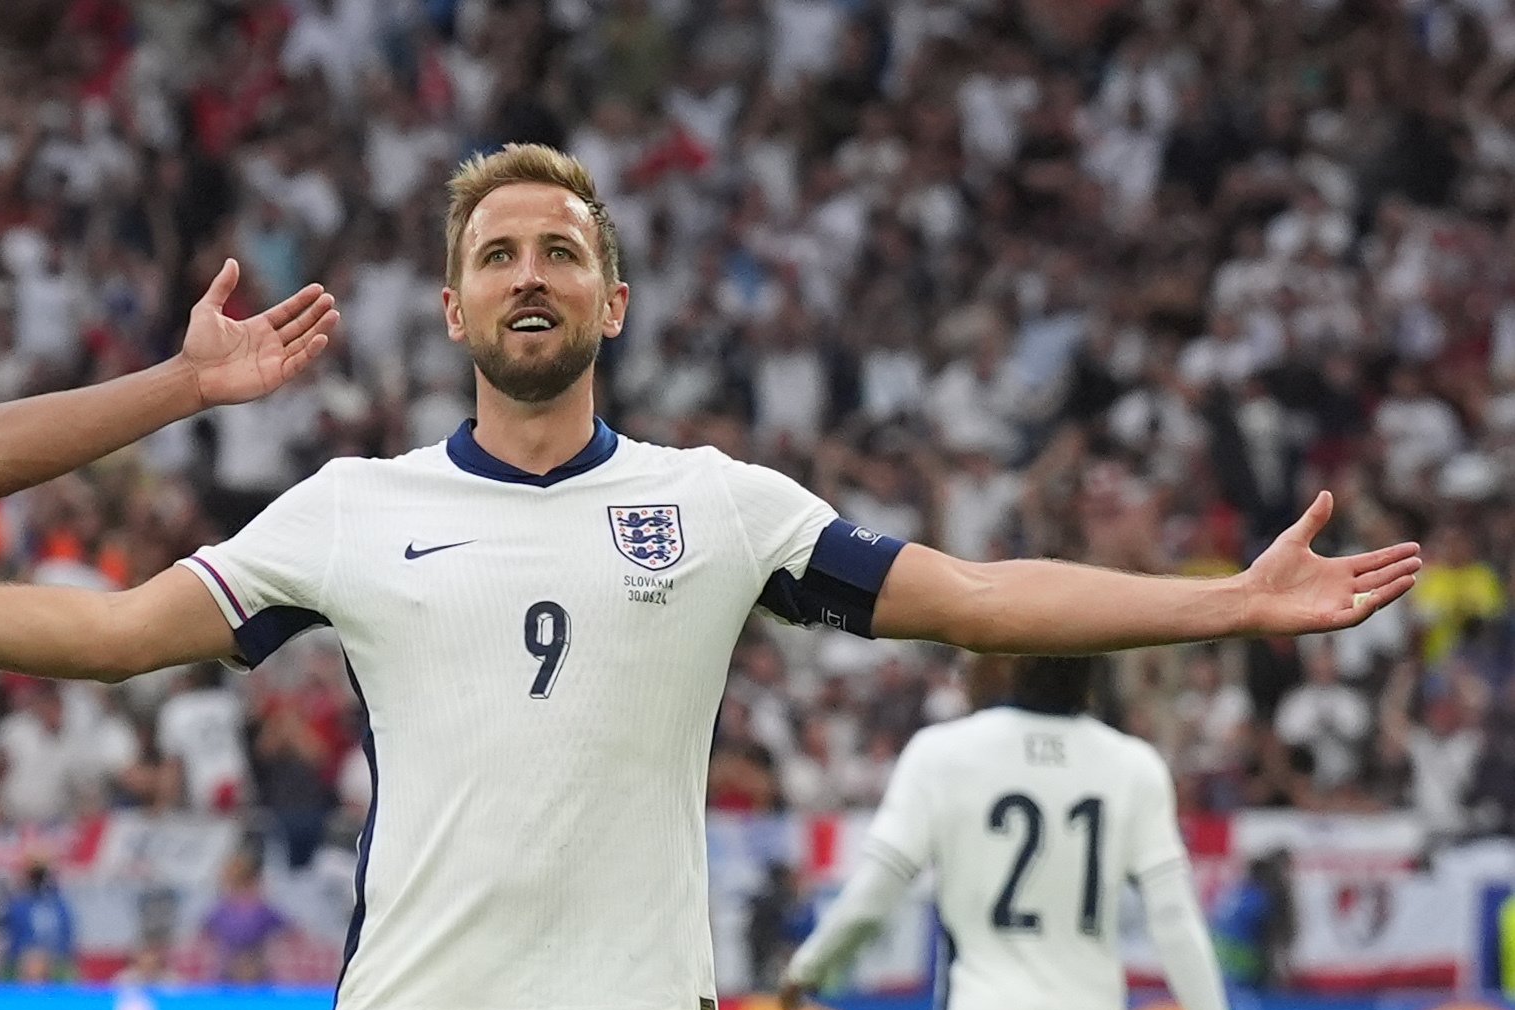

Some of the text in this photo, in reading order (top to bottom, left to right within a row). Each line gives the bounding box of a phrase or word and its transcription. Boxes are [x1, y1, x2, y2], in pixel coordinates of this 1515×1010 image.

[623, 575, 674, 590] SLOVAKIA
[628, 590, 667, 604] 30.06.24
[524, 600, 572, 699] 9
[989, 793, 1102, 935] 21
